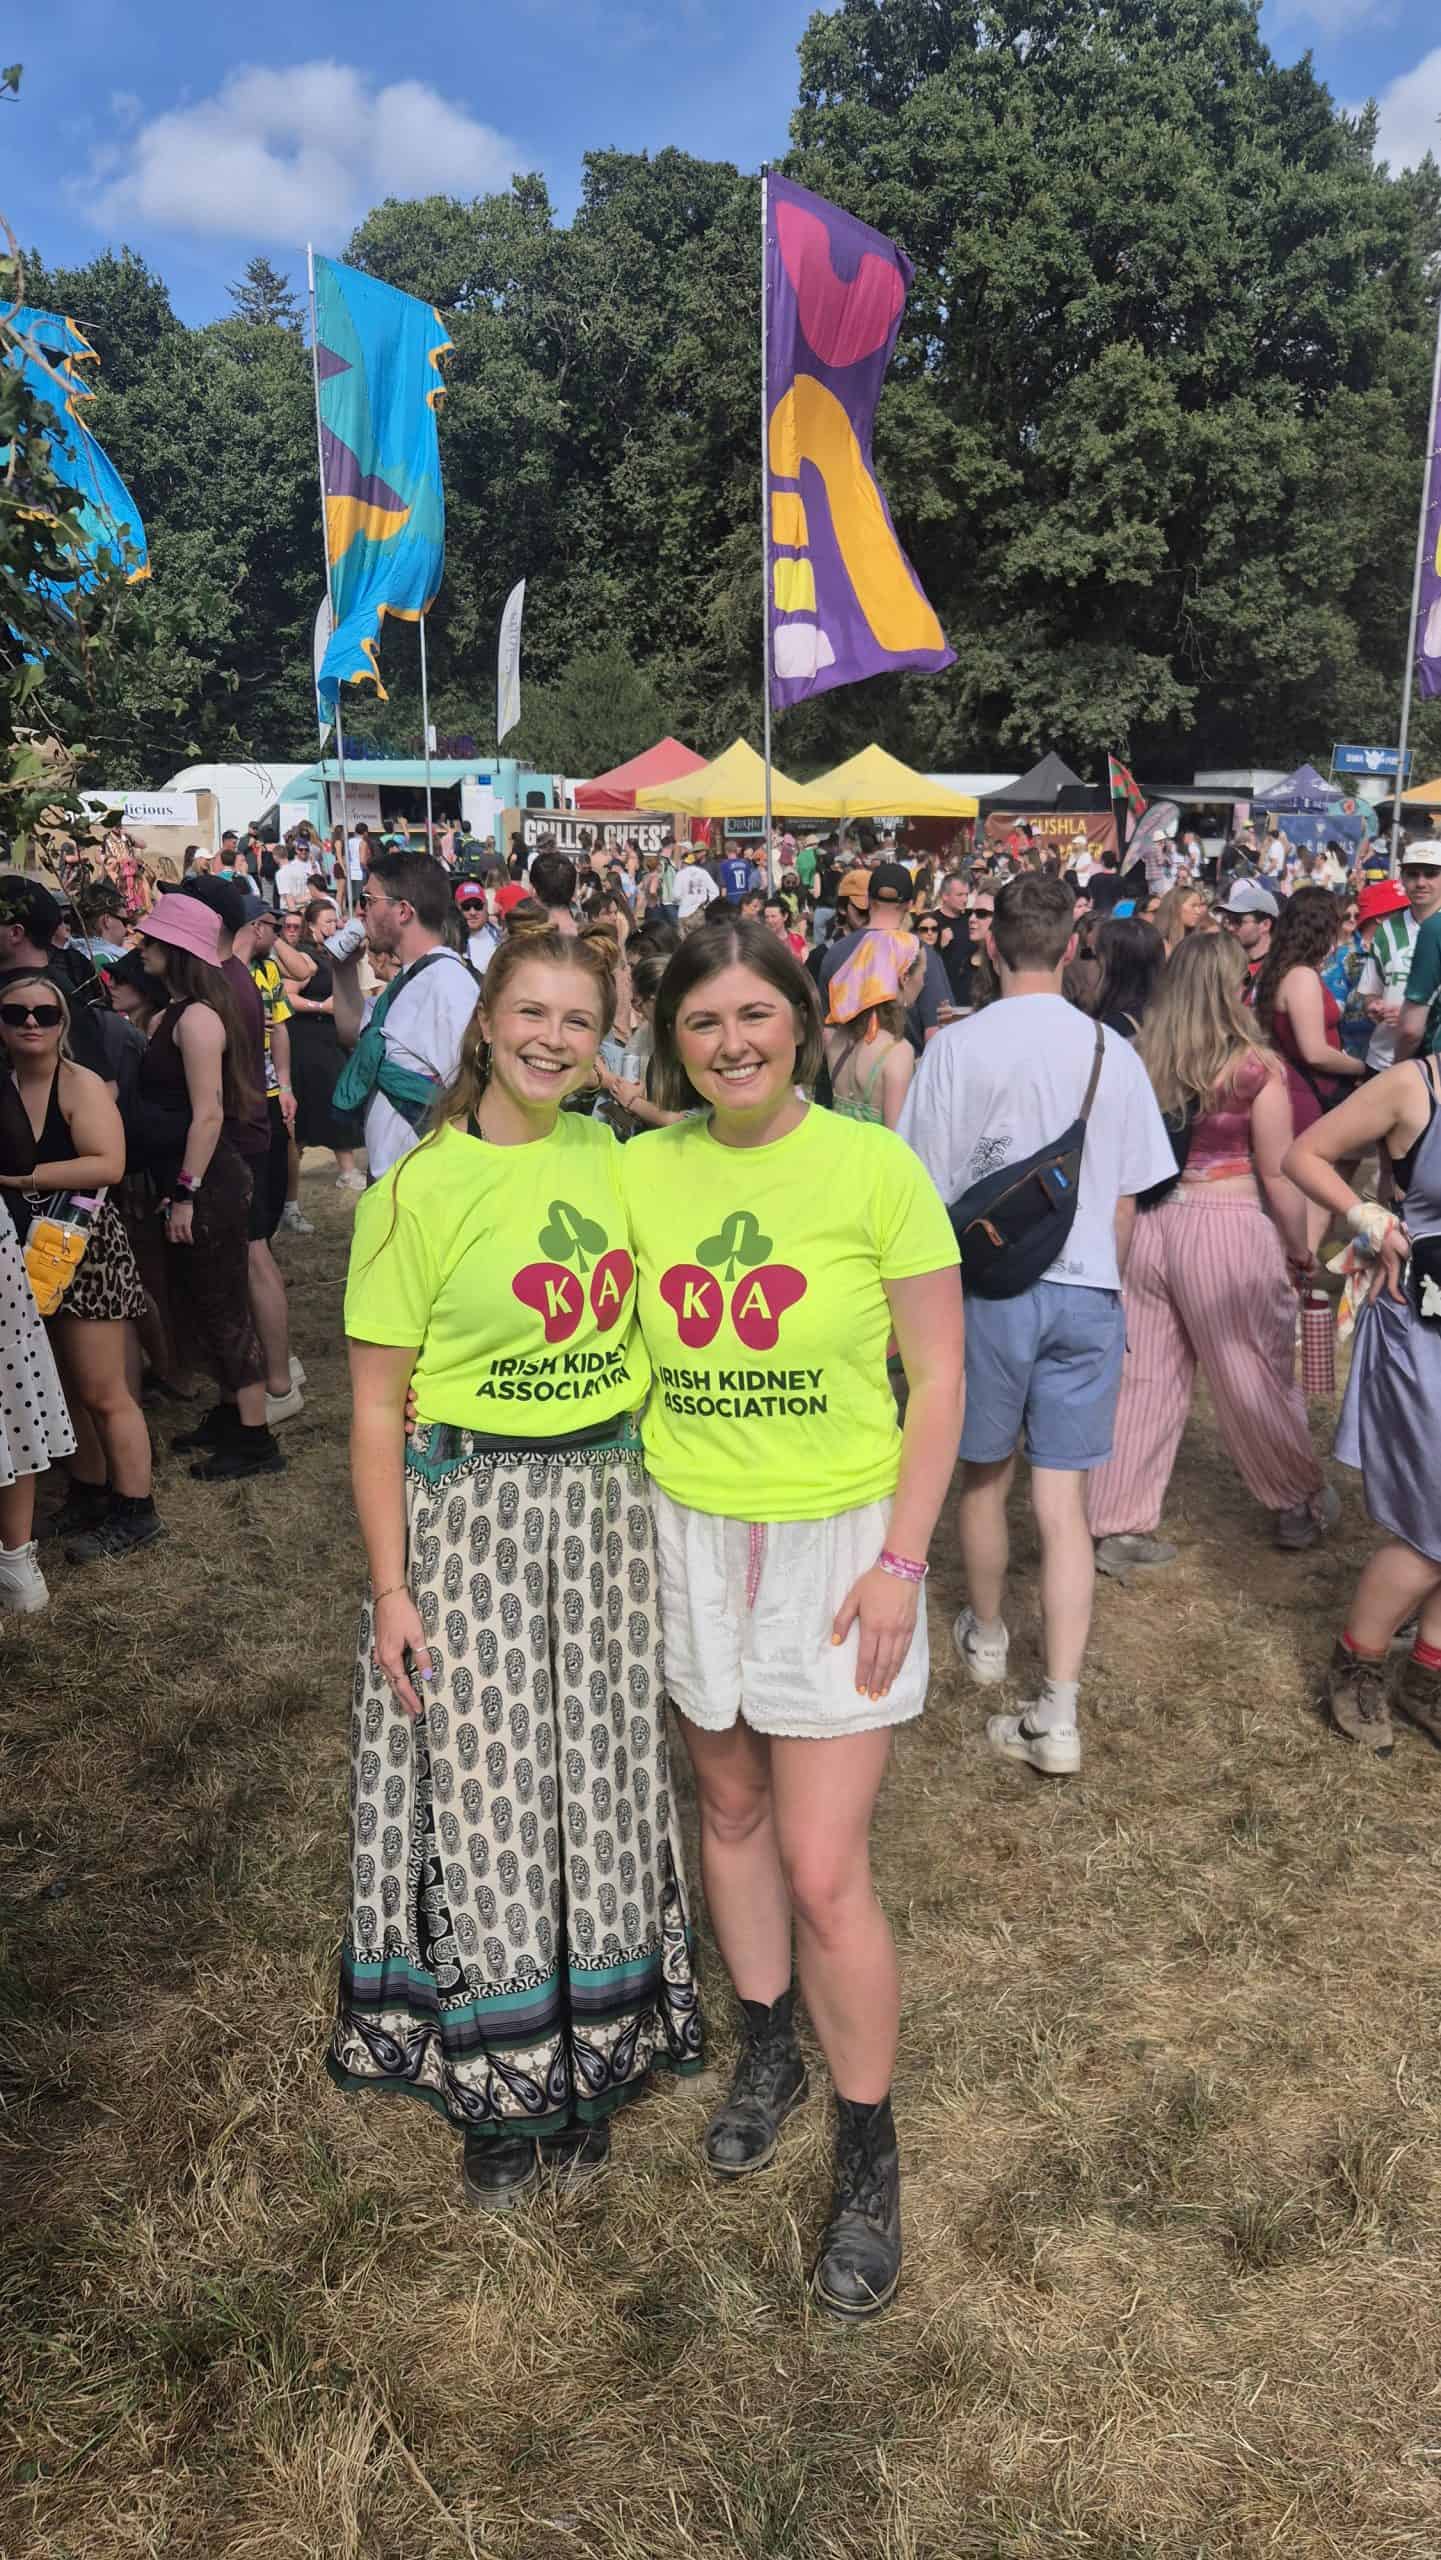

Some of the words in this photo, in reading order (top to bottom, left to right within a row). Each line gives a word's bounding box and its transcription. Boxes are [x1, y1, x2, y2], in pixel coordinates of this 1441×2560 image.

[734, 870, 745, 888] 10
[544, 1275, 576, 1319] K
[598, 1267, 620, 1308] A
[682, 1281, 711, 1319] K
[739, 1281, 772, 1319] A
[489, 1356, 558, 1377] IRISH
[659, 1365, 711, 1391] IRISH
[718, 1368, 824, 1391] KIDNEY
[664, 1391, 828, 1418] ASSOCIATION
